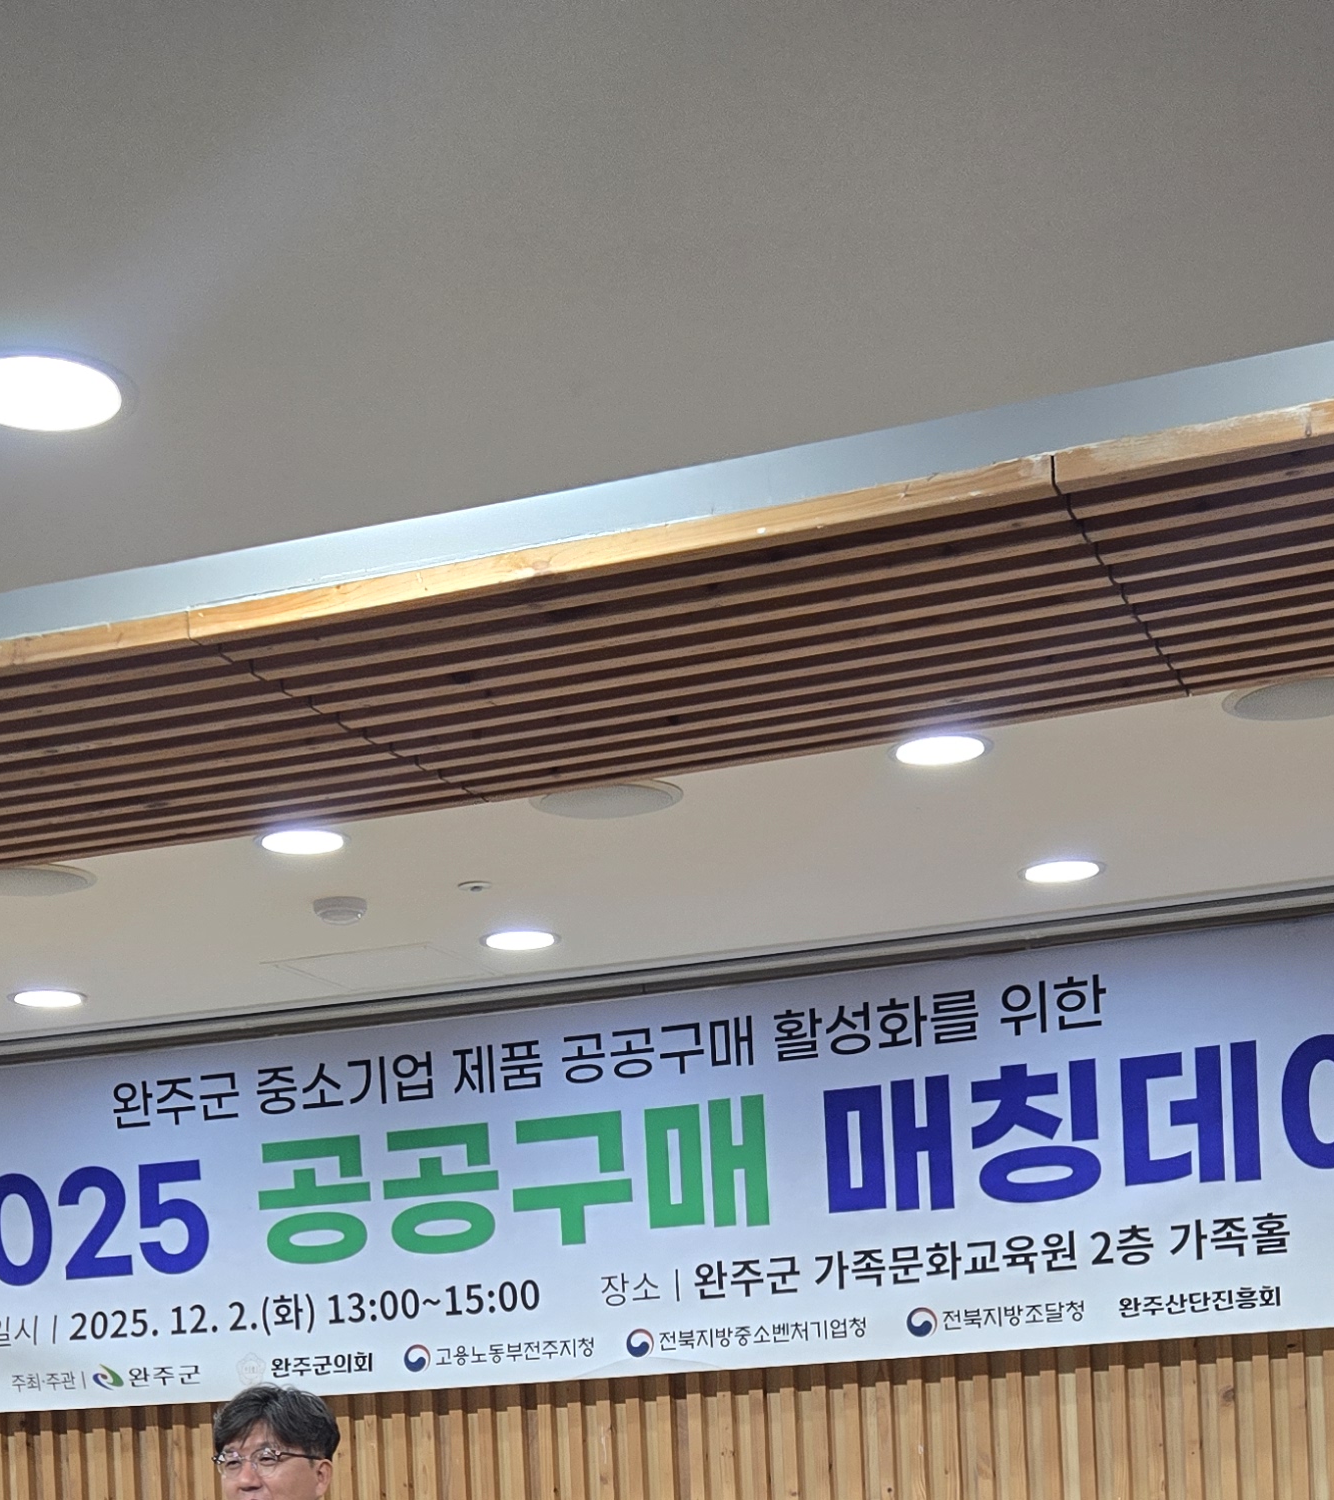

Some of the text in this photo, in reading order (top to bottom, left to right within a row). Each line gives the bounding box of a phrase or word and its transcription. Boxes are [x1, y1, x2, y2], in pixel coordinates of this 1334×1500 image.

[112, 973, 1107, 1130] 완주군 중소기업 제품 공공구매 활성화를 위한
[258, 1094, 770, 1265] 공공구매
[601, 1212, 1291, 1307] 장소 완주군 가족문화교육원 2층 가족홀
[328, 1279, 540, 1325] 13:00~15:00
[942, 1300, 1085, 1331] 전북지방조달청
[1118, 1285, 1281, 1319] 완주산단진흥회
[435, 1336, 595, 1366] 고용노동부전주지청
[659, 1316, 867, 1352] 전북지방중소벤처기업청
[128, 1365, 201, 1388] 완주군
[270, 1351, 374, 1379] 완주군의회
